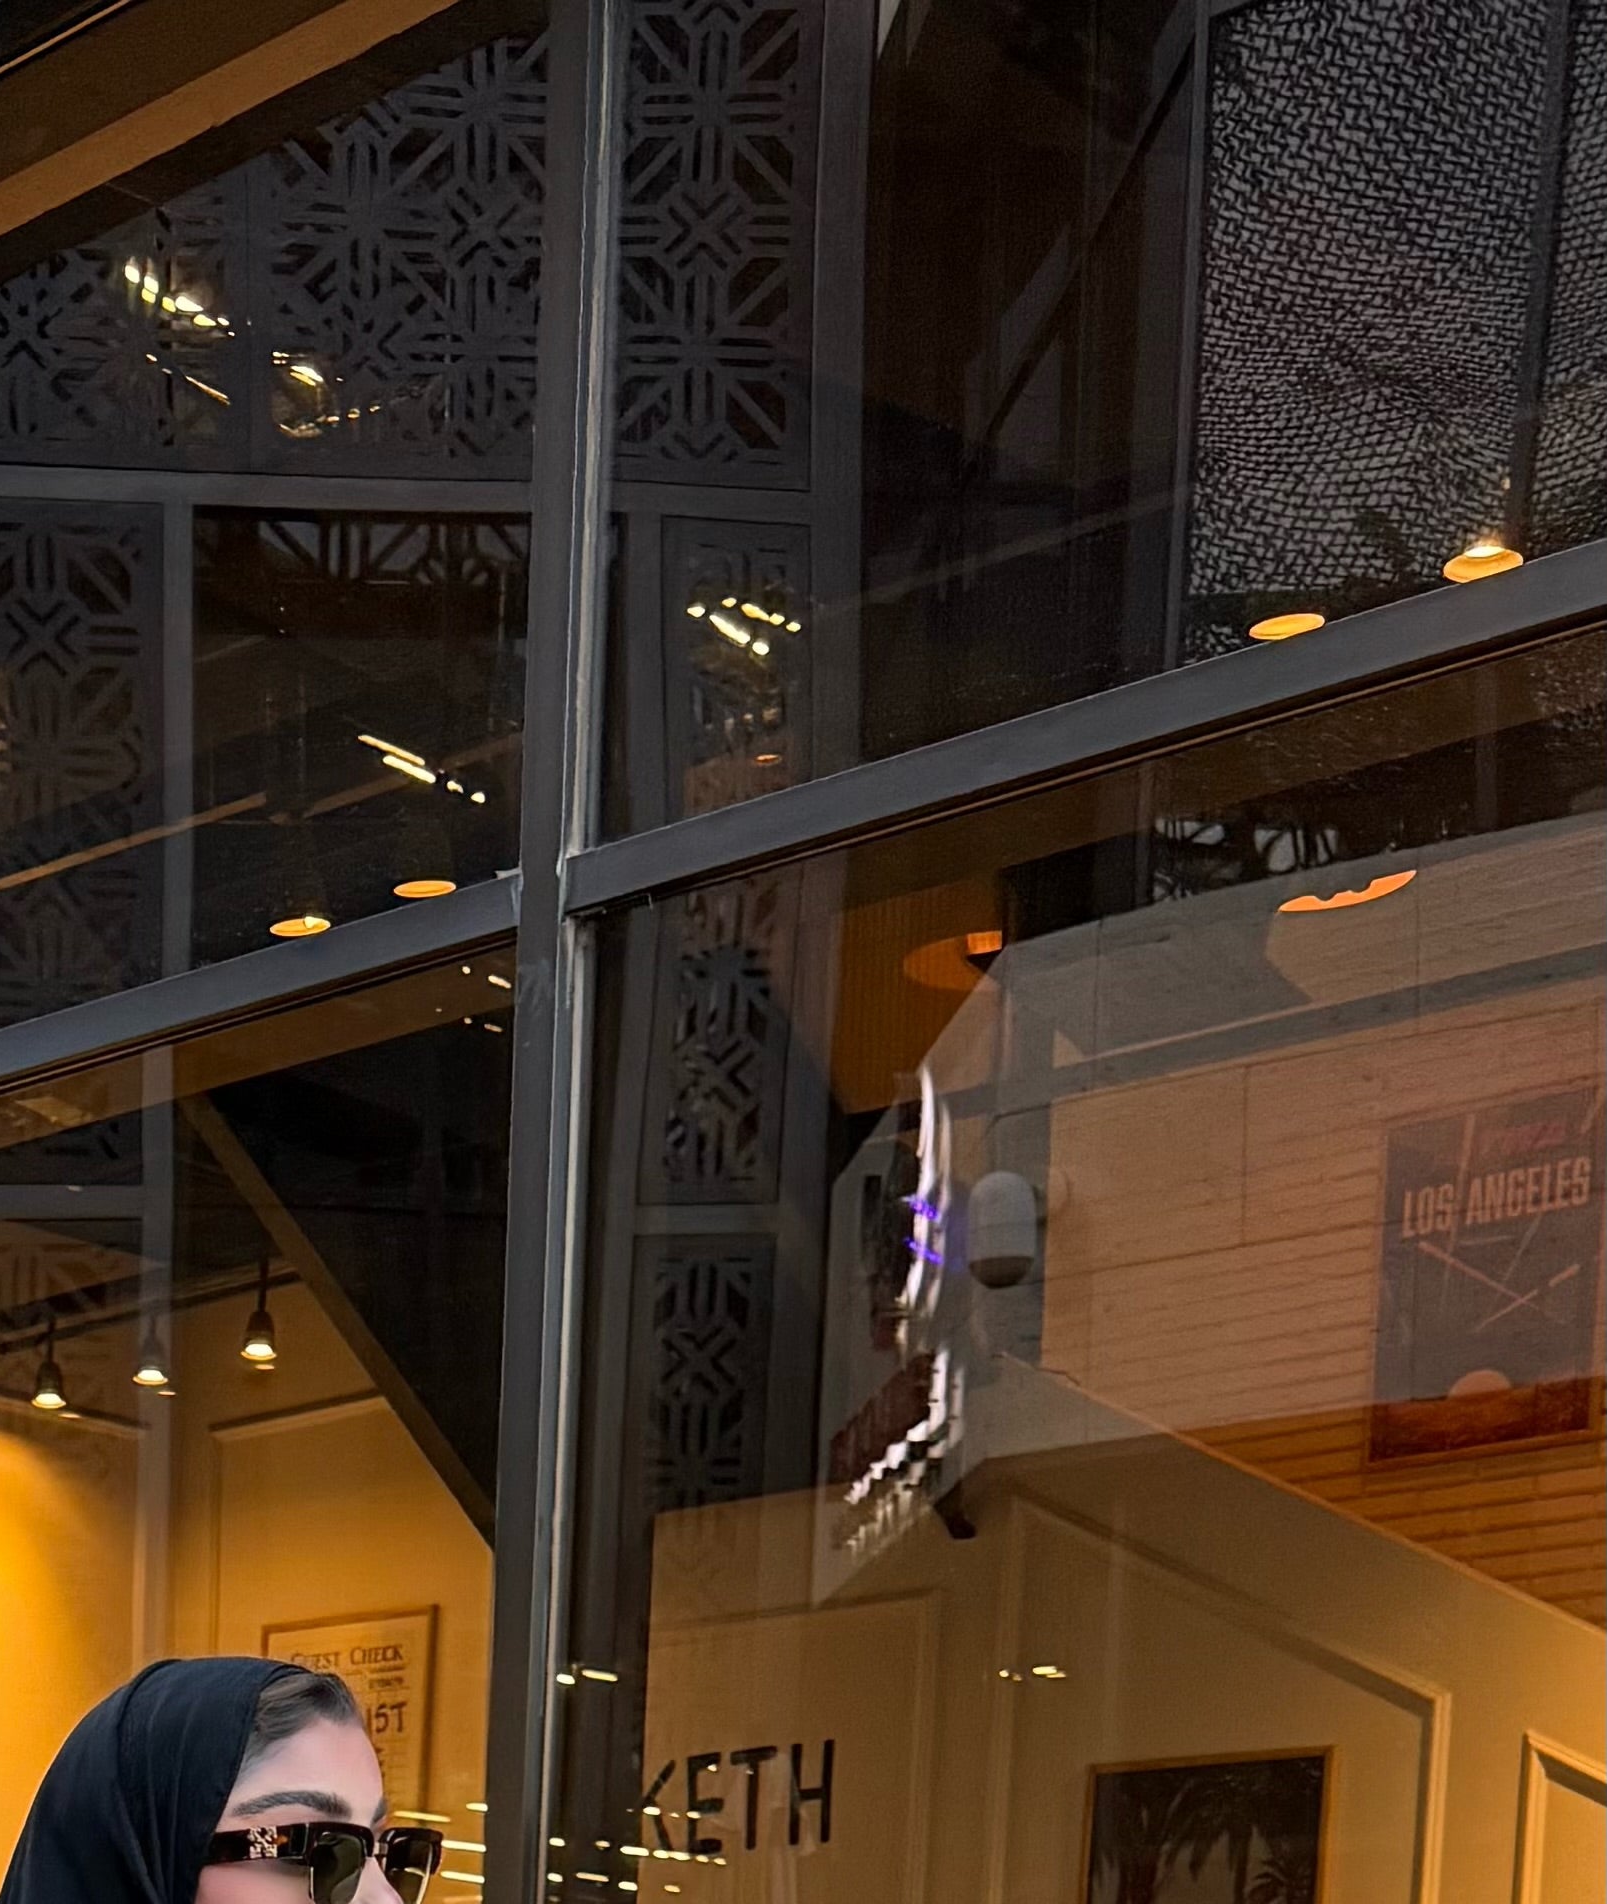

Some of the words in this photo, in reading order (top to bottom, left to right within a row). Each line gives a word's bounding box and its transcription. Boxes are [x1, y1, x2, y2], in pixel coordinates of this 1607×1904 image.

[1401, 1183, 1456, 1239] LOS
[1465, 1156, 1592, 1226] ANGELES
[350, 1644, 404, 1665] CHECK
